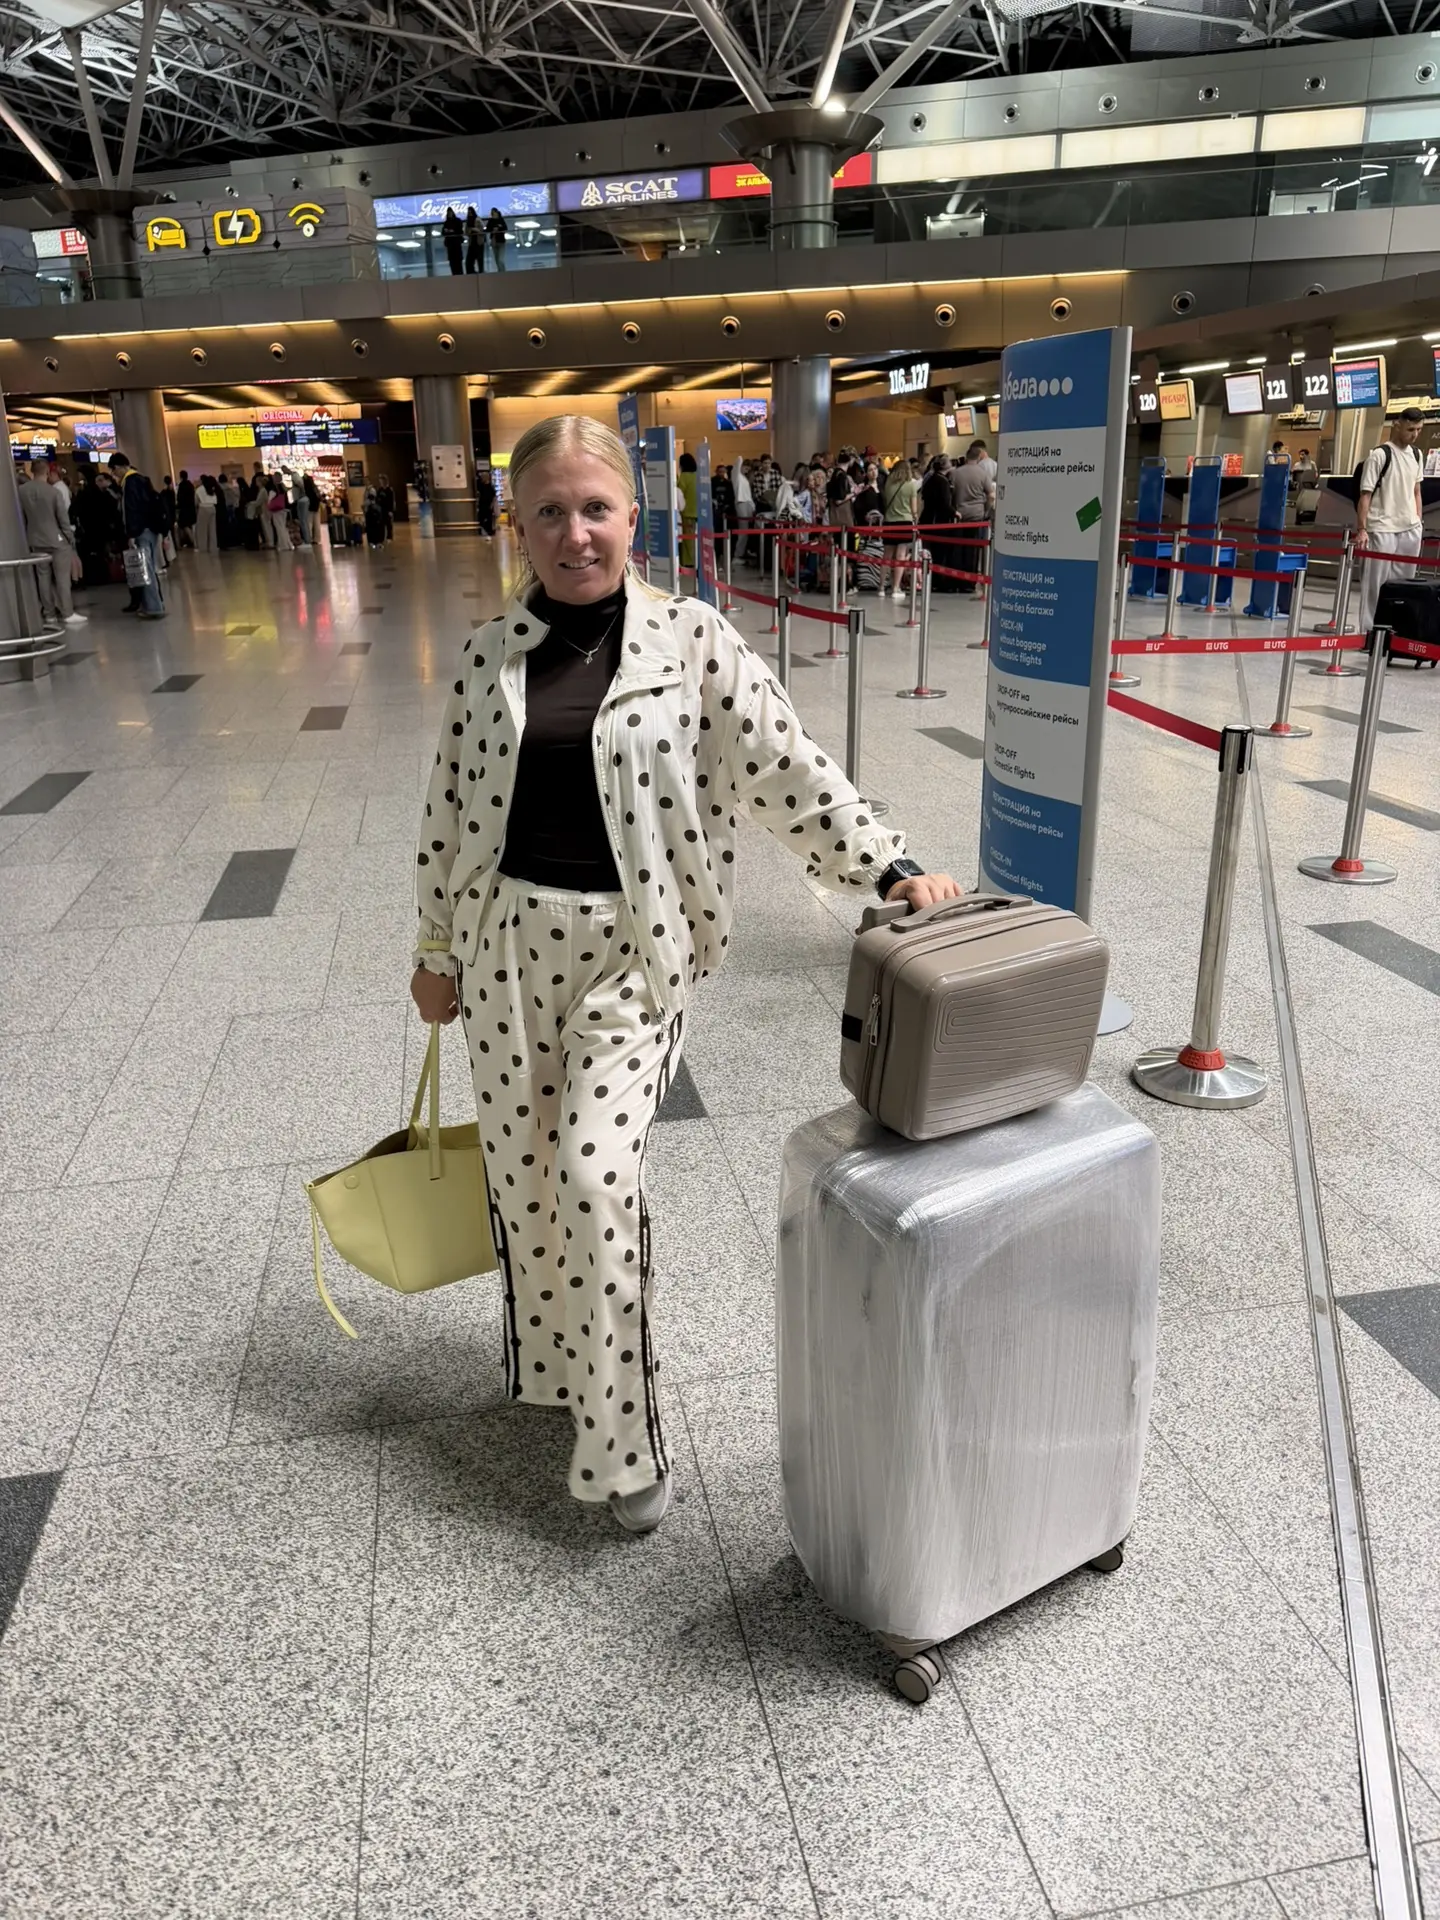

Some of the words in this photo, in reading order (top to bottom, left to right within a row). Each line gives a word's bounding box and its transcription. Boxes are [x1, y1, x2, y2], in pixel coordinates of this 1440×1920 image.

[605, 177, 678, 196] SCAT
[606, 190, 679, 203] AIRLINES
[1266, 379, 1288, 400] 121
[1305, 374, 1329, 396] 122
[1139, 393, 1157, 411] 120
[1161, 392, 1187, 404] PEGASUS
[263, 410, 303, 420] ORIGINAL
[1050, 448, 1062, 457] на
[1066, 461, 1095, 475] рейсы
[1004, 514, 1029, 526] CHECK-IN
[1026, 532, 1049, 545] flights
[1044, 576, 1055, 585] на
[1014, 602, 1025, 612] без
[1025, 603, 1054, 616] багажа
[1016, 637, 1047, 652] baggage
[1213, 641, 1229, 650] UTG
[1271, 640, 1287, 649] UTG
[1414, 644, 1427, 654] UTG
[1019, 652, 1043, 666] flights
[1020, 694, 1030, 702] на
[1052, 713, 1079, 725] рейсы
[1013, 765, 1035, 780] flights
[1037, 825, 1064, 838] рейсы
[1020, 876, 1044, 892] flights
